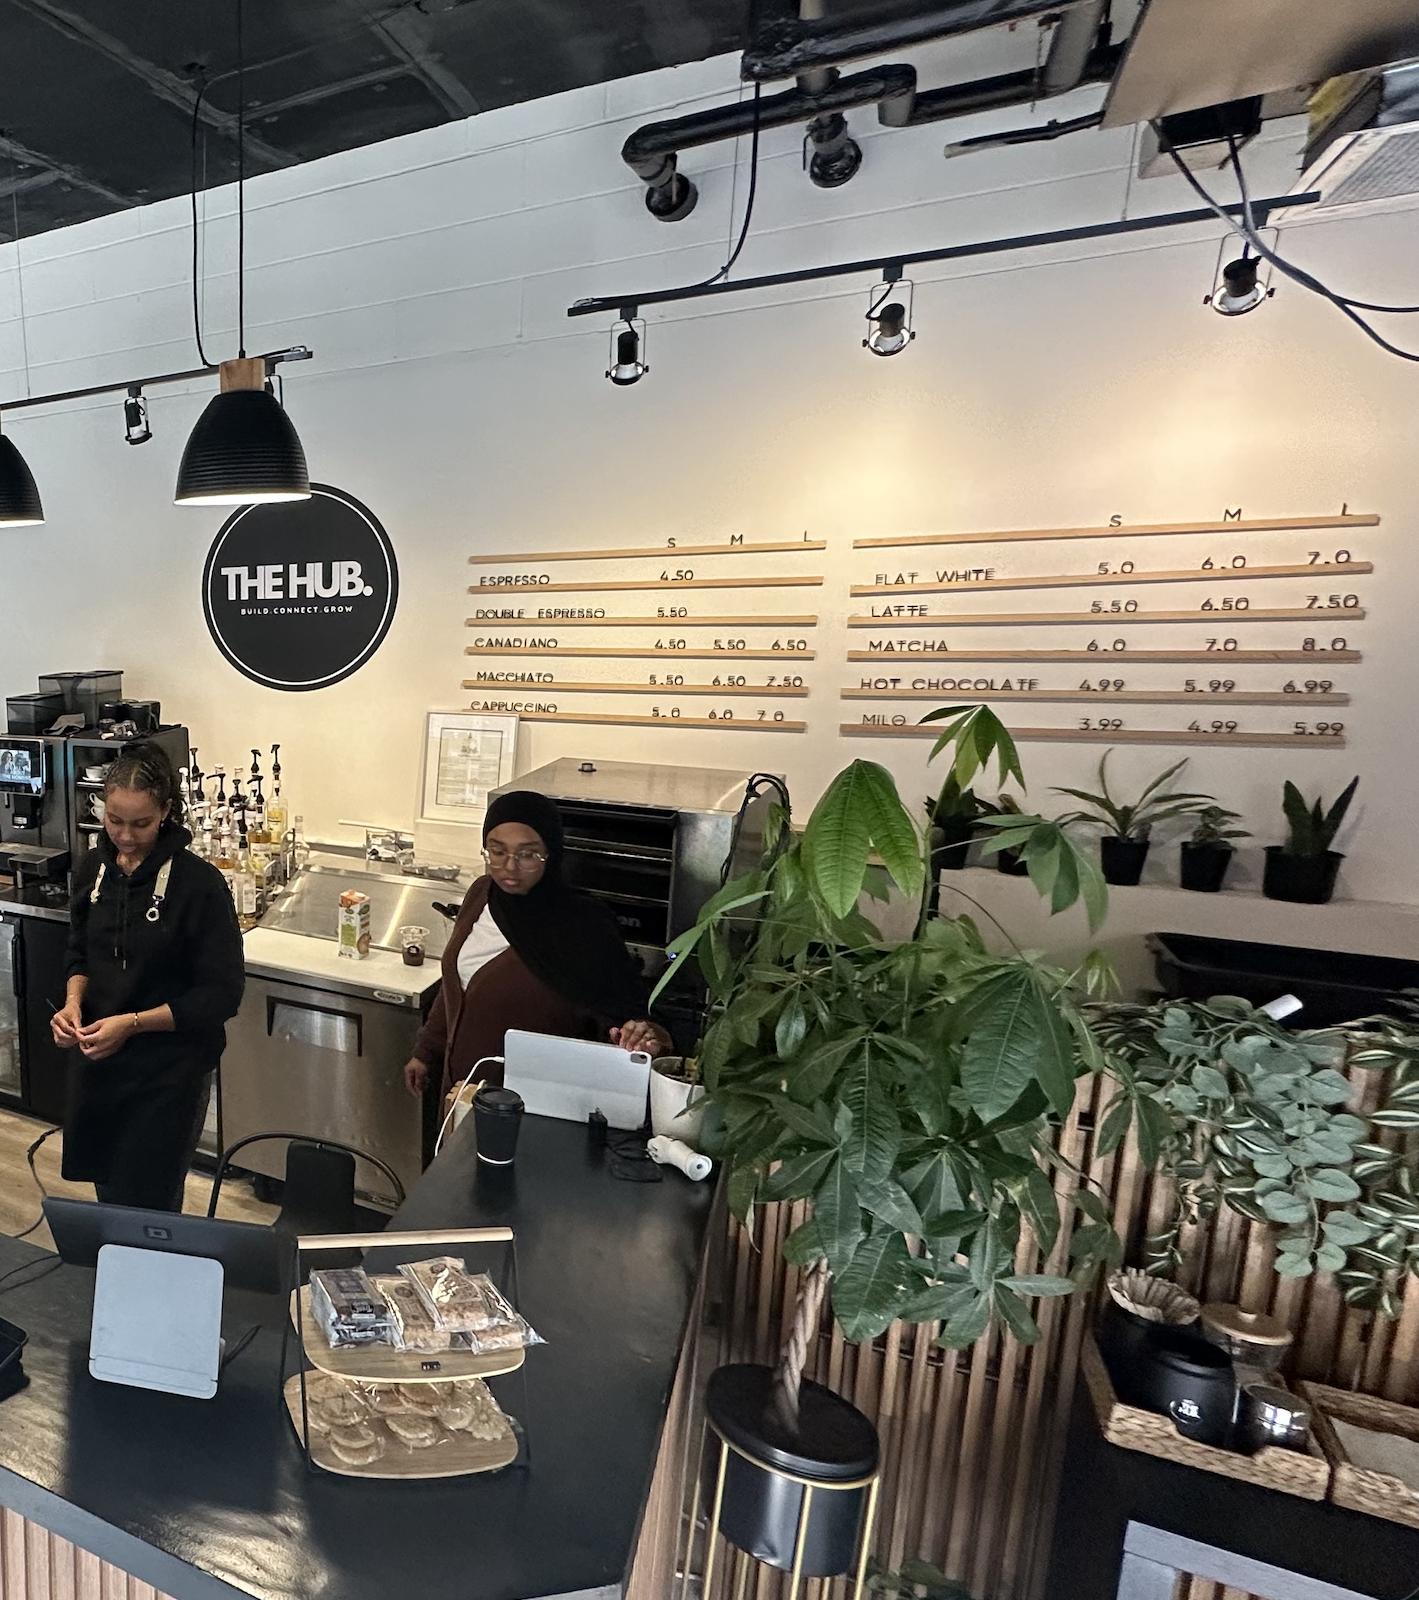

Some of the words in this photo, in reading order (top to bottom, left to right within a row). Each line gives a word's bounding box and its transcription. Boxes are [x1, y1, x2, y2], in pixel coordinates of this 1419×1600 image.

[1109, 514, 1122, 527] S
[1224, 508, 1242, 521] M
[1341, 502, 1353, 516] L
[667, 537, 676, 549] S
[730, 534, 744, 545] M
[804, 530, 812, 542] L
[221, 564, 283, 600] THE
[288, 560, 374, 599] HUB.
[480, 574, 550, 587] ESPRESSO
[875, 572, 920, 586] FLAT
[936, 567, 996, 583] WHITE
[1098, 560, 1134, 575] 5.0
[476, 608, 525, 619] DOUBLE
[538, 608, 605, 619] ESPRESSO
[657, 606, 688, 618] 5.50
[871, 605, 929, 618] LATTE
[1090, 599, 1138, 614] 5.50
[1200, 597, 1249, 611] 6.50
[1305, 594, 1359, 609] 7.50
[474, 637, 558, 648] CANADIANO
[654, 639, 686, 650] 4.50
[713, 639, 746, 651] 5.50
[771, 639, 807, 651] 6.50
[868, 640, 948, 652] MATCHA
[1086, 638, 1127, 651] 6.0
[1205, 638, 1238, 652] 7.0
[476, 671, 554, 683] MACCHIATO
[649, 674, 684, 686] 5.50
[712, 675, 746, 687] 6.50
[860, 678, 901, 690] HOT
[911, 678, 1041, 691] CHOCOLATE
[1079, 679, 1125, 692] 4.99
[1184, 679, 1236, 693] 5.99
[1283, 680, 1333, 694] 6.99
[471, 701, 558, 713] CAPPUCCINO
[862, 714, 907, 727] MILO
[1079, 718, 1123, 731] 3.99
[1187, 720, 1237, 733] 4.99
[1293, 721, 1344, 735] 5.99
